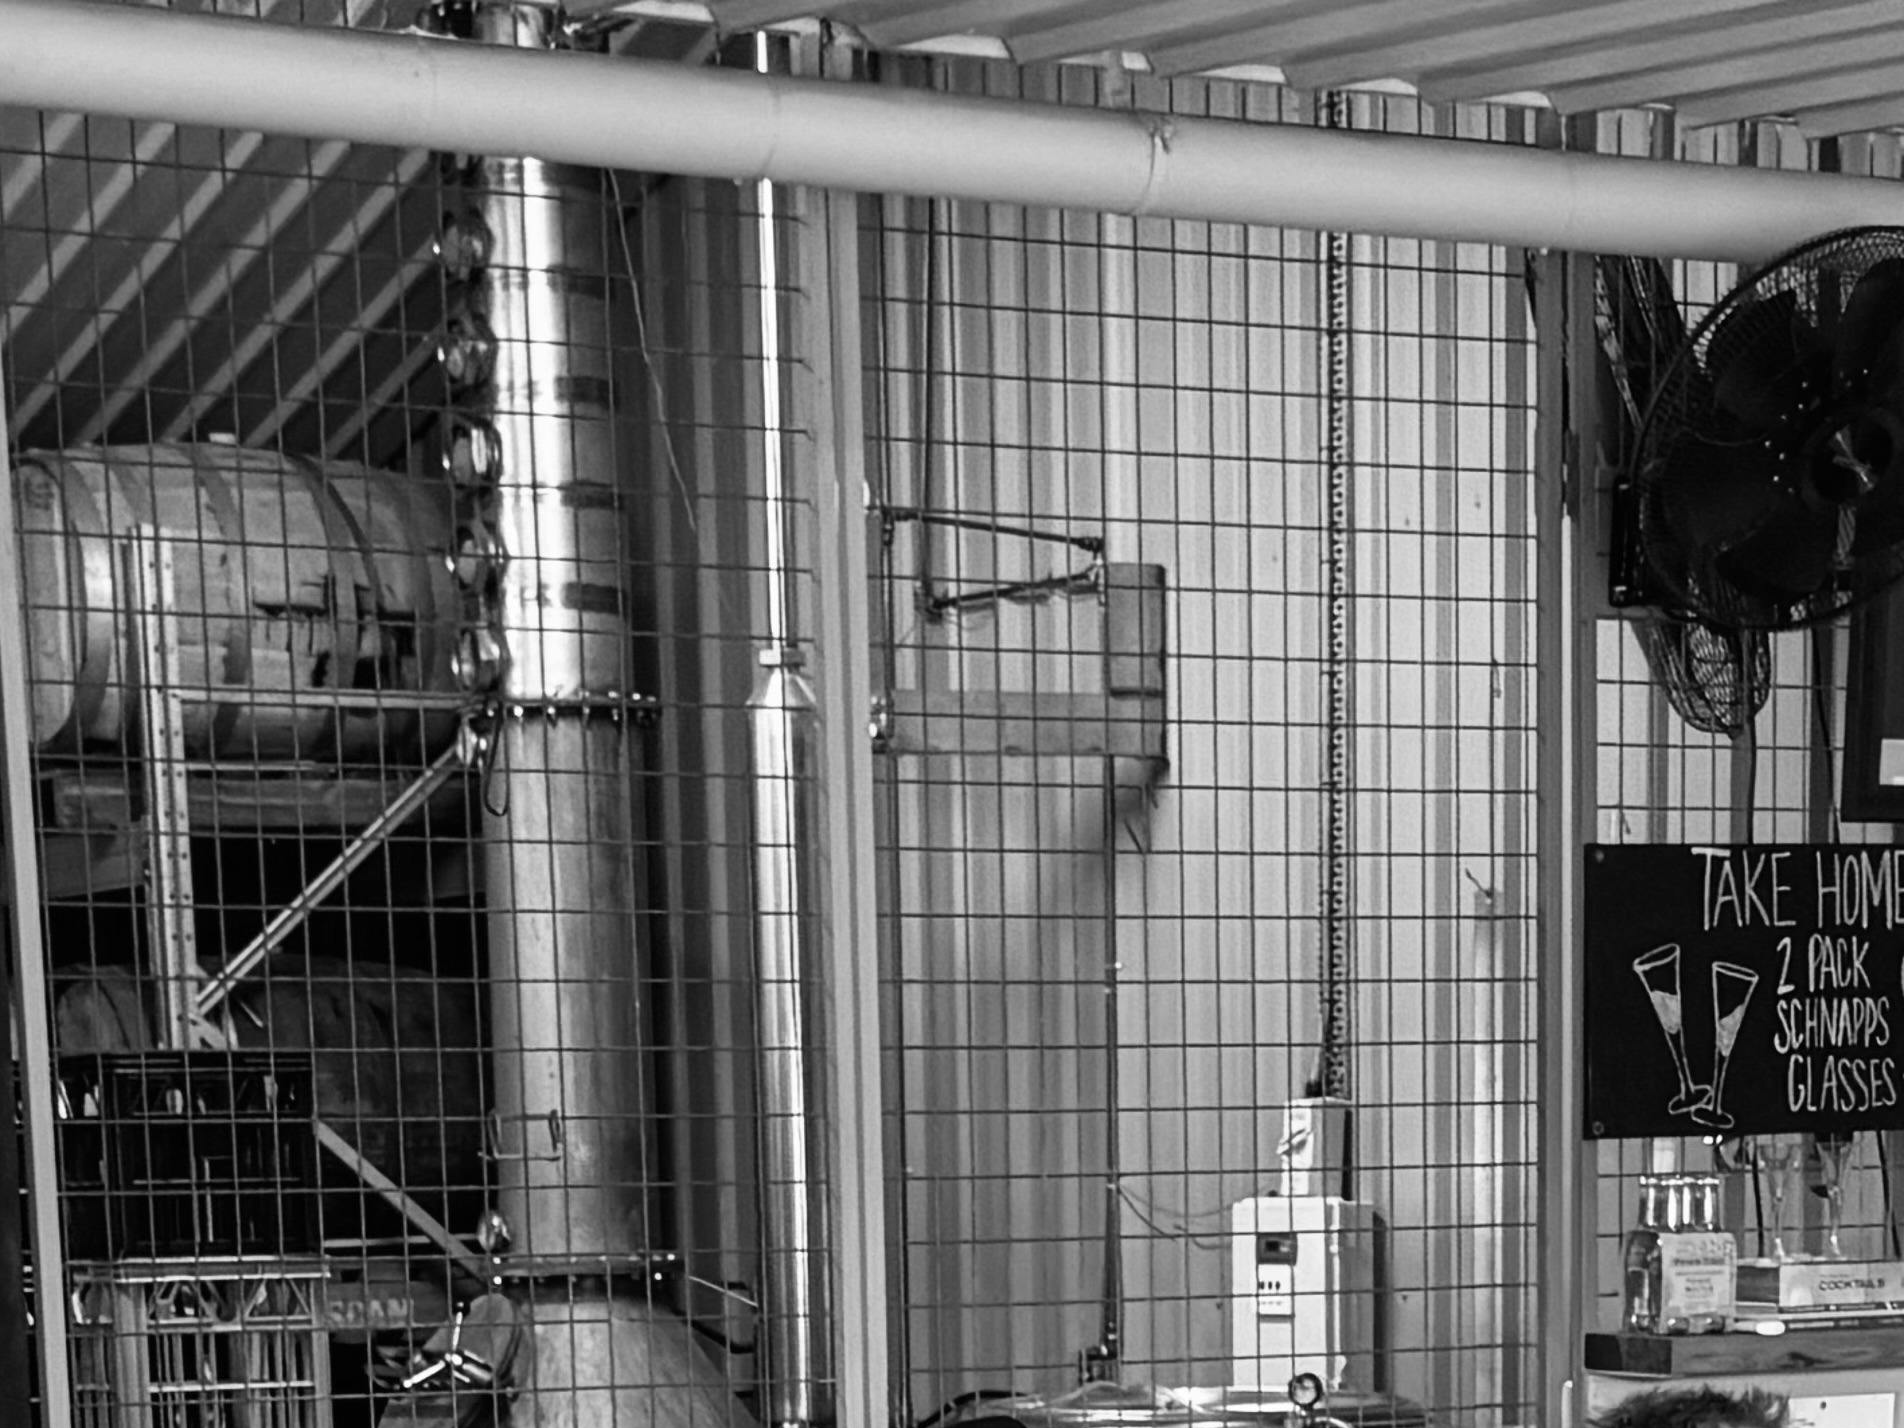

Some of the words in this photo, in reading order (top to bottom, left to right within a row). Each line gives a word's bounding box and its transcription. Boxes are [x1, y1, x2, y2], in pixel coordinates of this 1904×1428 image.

[1690, 846, 1797, 932] TAKE
[1776, 936, 1796, 996] 2
[1807, 933, 1871, 993] PACK
[1773, 995, 1890, 1055] SCHNAPPS
[1787, 1053, 1897, 1113] GLASSES
